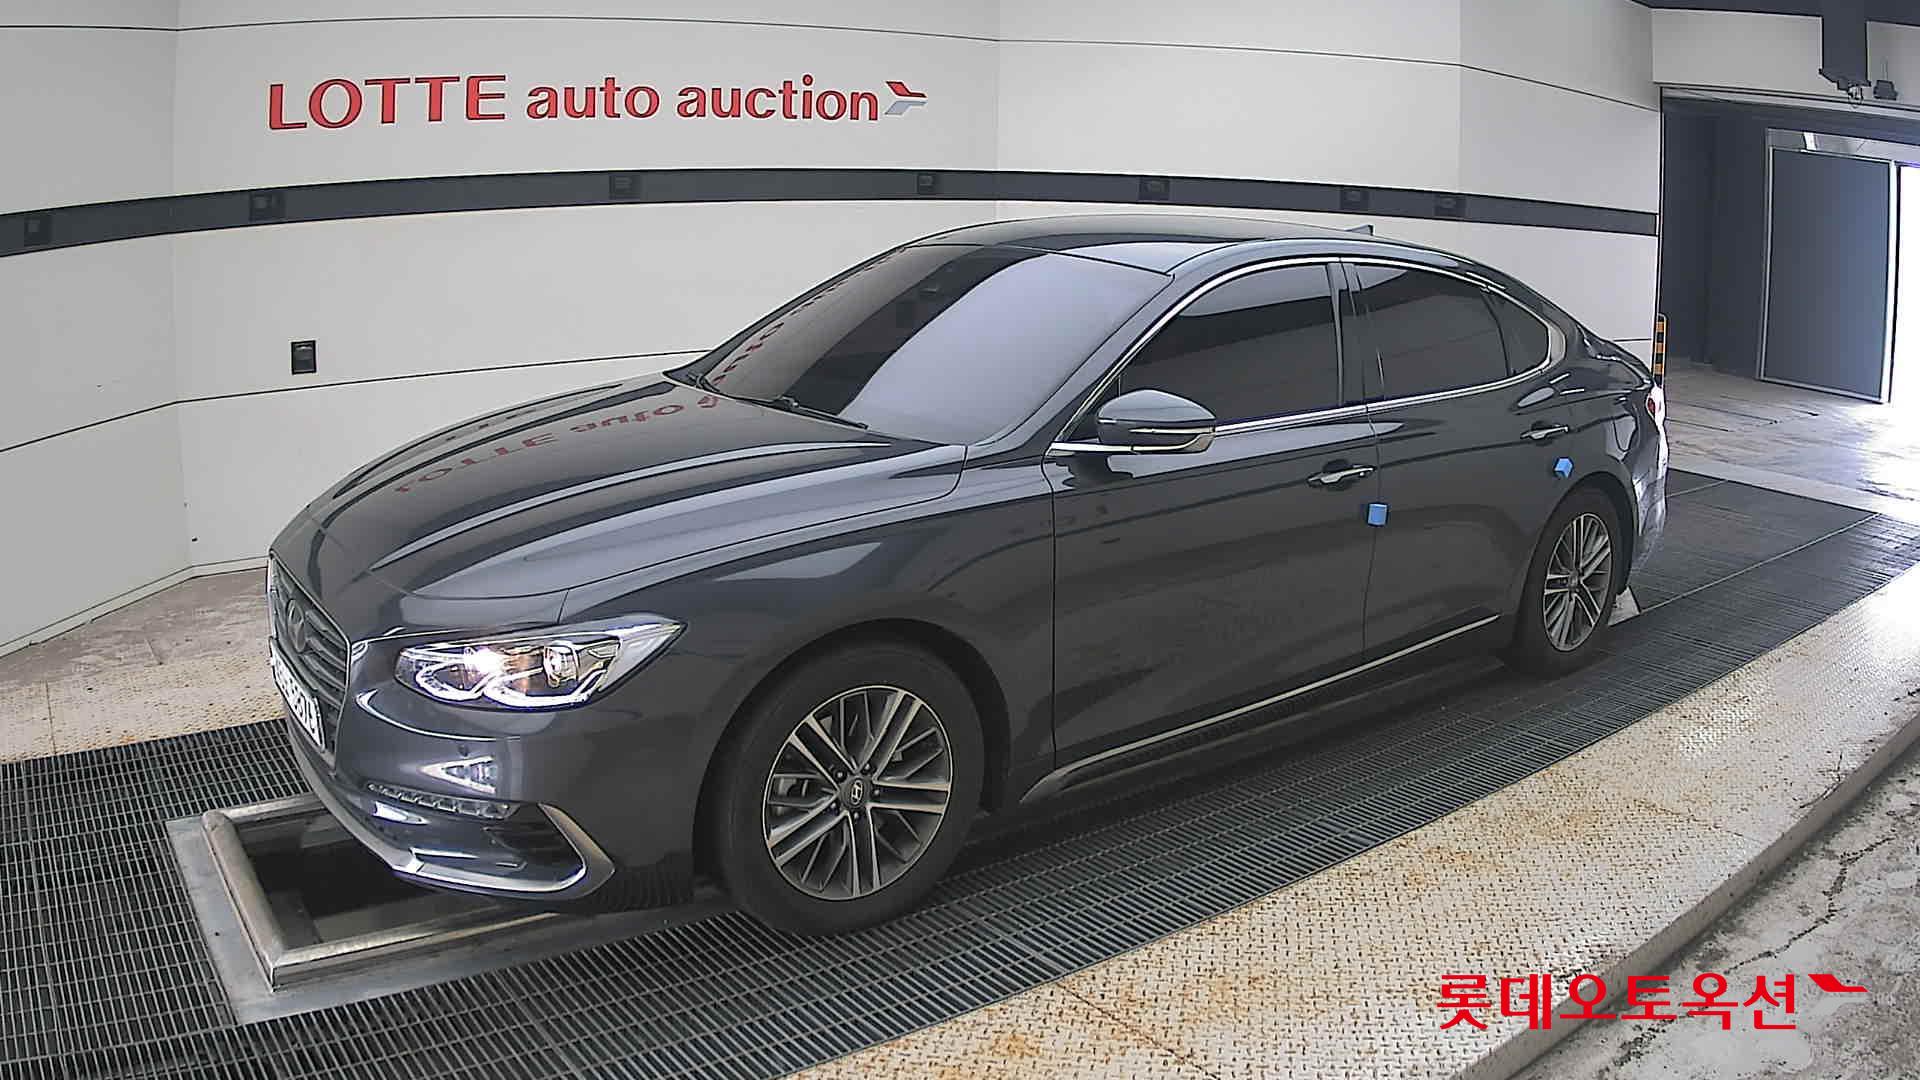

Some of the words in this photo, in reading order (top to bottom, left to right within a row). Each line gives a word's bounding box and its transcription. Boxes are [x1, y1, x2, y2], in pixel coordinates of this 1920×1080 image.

[269, 75, 506, 130] LOTTE
[526, 76, 661, 120] auto
[676, 74, 880, 121] auction
